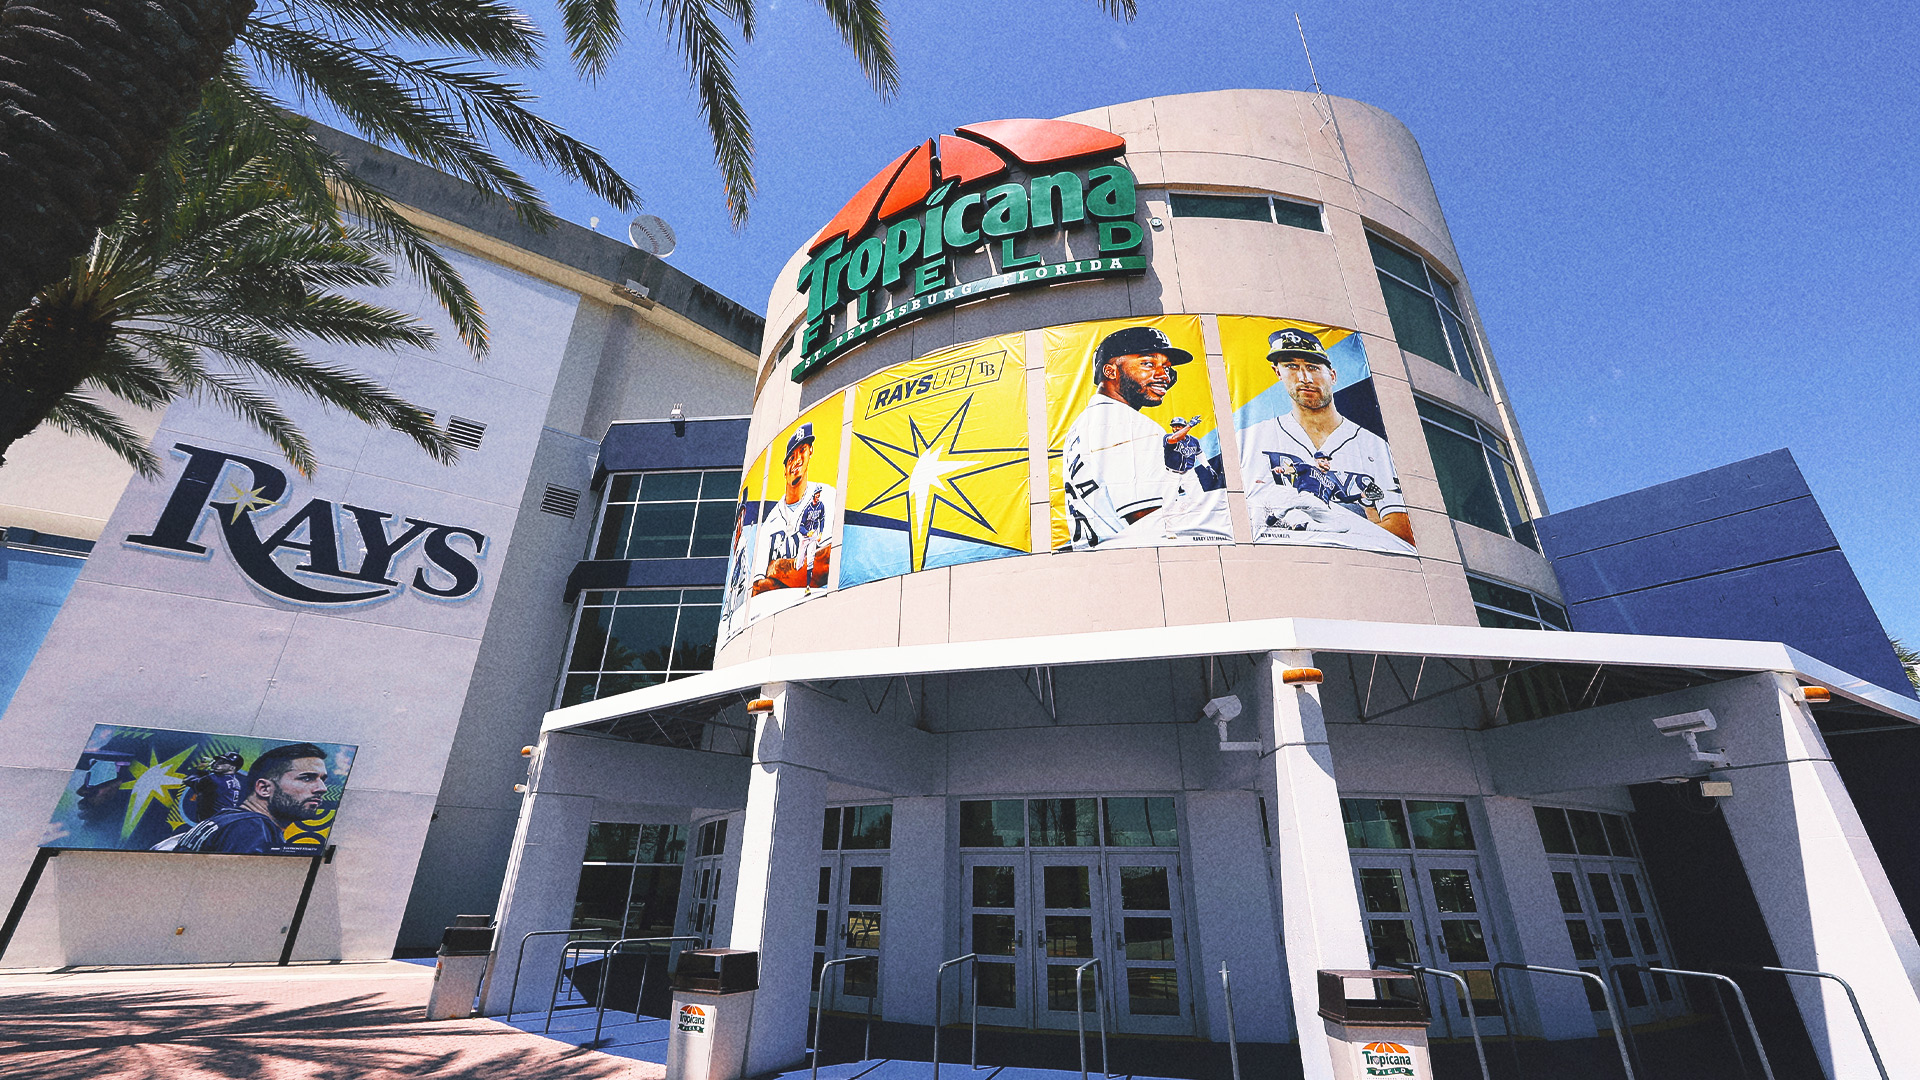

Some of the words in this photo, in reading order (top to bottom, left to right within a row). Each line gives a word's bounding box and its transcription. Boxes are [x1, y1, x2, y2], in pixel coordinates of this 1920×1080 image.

[798, 165, 1136, 324] Tropicana
[801, 221, 1145, 355] FIELD
[804, 352, 827, 368] ST.
[1003, 257, 1123, 284] FLORIDA
[976, 360, 996, 377] TB
[1262, 451, 1377, 507] RYS
[124, 442, 489, 605] RAYS
[680, 1010, 706, 1025] Tropicana
[1362, 1050, 1411, 1067] Tropicana
